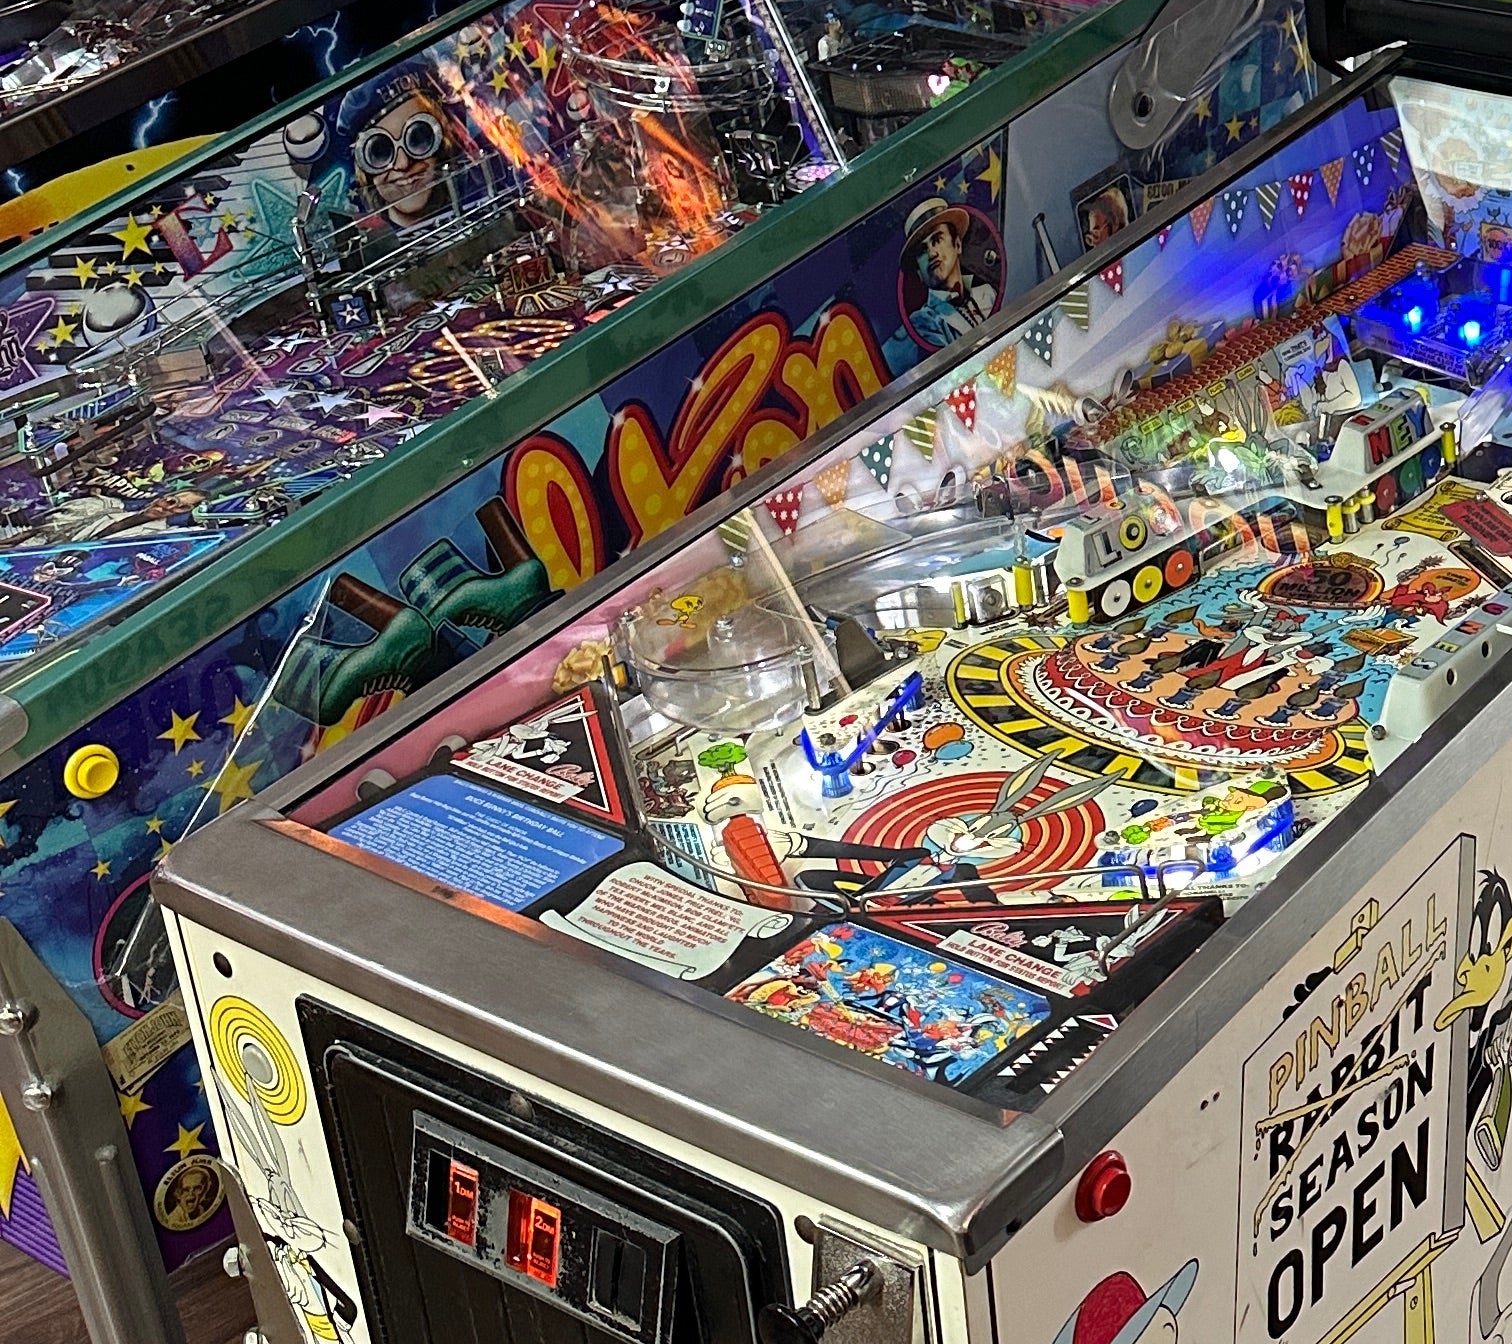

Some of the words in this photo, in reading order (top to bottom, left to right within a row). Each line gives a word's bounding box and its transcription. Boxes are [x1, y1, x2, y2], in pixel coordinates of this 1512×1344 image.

[1367, 402, 1427, 466] NEY
[86, 474, 158, 499] CAPTAIN
[1279, 582, 1360, 598] MILLION
[1314, 569, 1352, 588] 50
[466, 761, 482, 770] HOLD
[482, 766, 505, 777] BUTTON
[505, 773, 518, 782] FOR
[516, 777, 540, 791] STATUS
[539, 787, 564, 799] REPORT
[486, 759, 517, 774] LANE
[516, 769, 565, 790] CHANGE
[509, 813, 549, 830] BIRTHDAY
[543, 826, 567, 837] BALL
[611, 879, 641, 893] ROBERT
[629, 878, 657, 891] CHUCK
[686, 900, 704, 909] FRIZ
[665, 883, 696, 898] SPECIAL
[698, 896, 730, 911] THANKS
[577, 917, 632, 940] THROUGHOUT
[592, 906, 636, 925] HAPPINESS
[653, 929, 696, 949] LAUGHTER
[614, 906, 635, 916] HAVE
[635, 914, 673, 931] BROUGHT
[687, 934, 710, 946] MUCH
[624, 901, 656, 916] WARNER
[681, 923, 727, 944] ANIMATORS
[636, 931, 665, 945] WORLD
[970, 921, 1028, 949] Bally
[946, 941, 966, 952] HOLD
[964, 948, 995, 962] BUTTON
[994, 957, 1010, 969] FOR
[1008, 964, 1037, 982] STATUS
[1035, 975, 1067, 990] REPORT
[967, 939, 1005, 957] LANE
[1004, 953, 1062, 979] CHANGE
[1268, 892, 1448, 1113] PINBALL
[1269, 969, 1433, 1179] RABBIT
[1270, 1042, 1435, 1242] SEASON
[1267, 1119, 1430, 1341] OPEN
